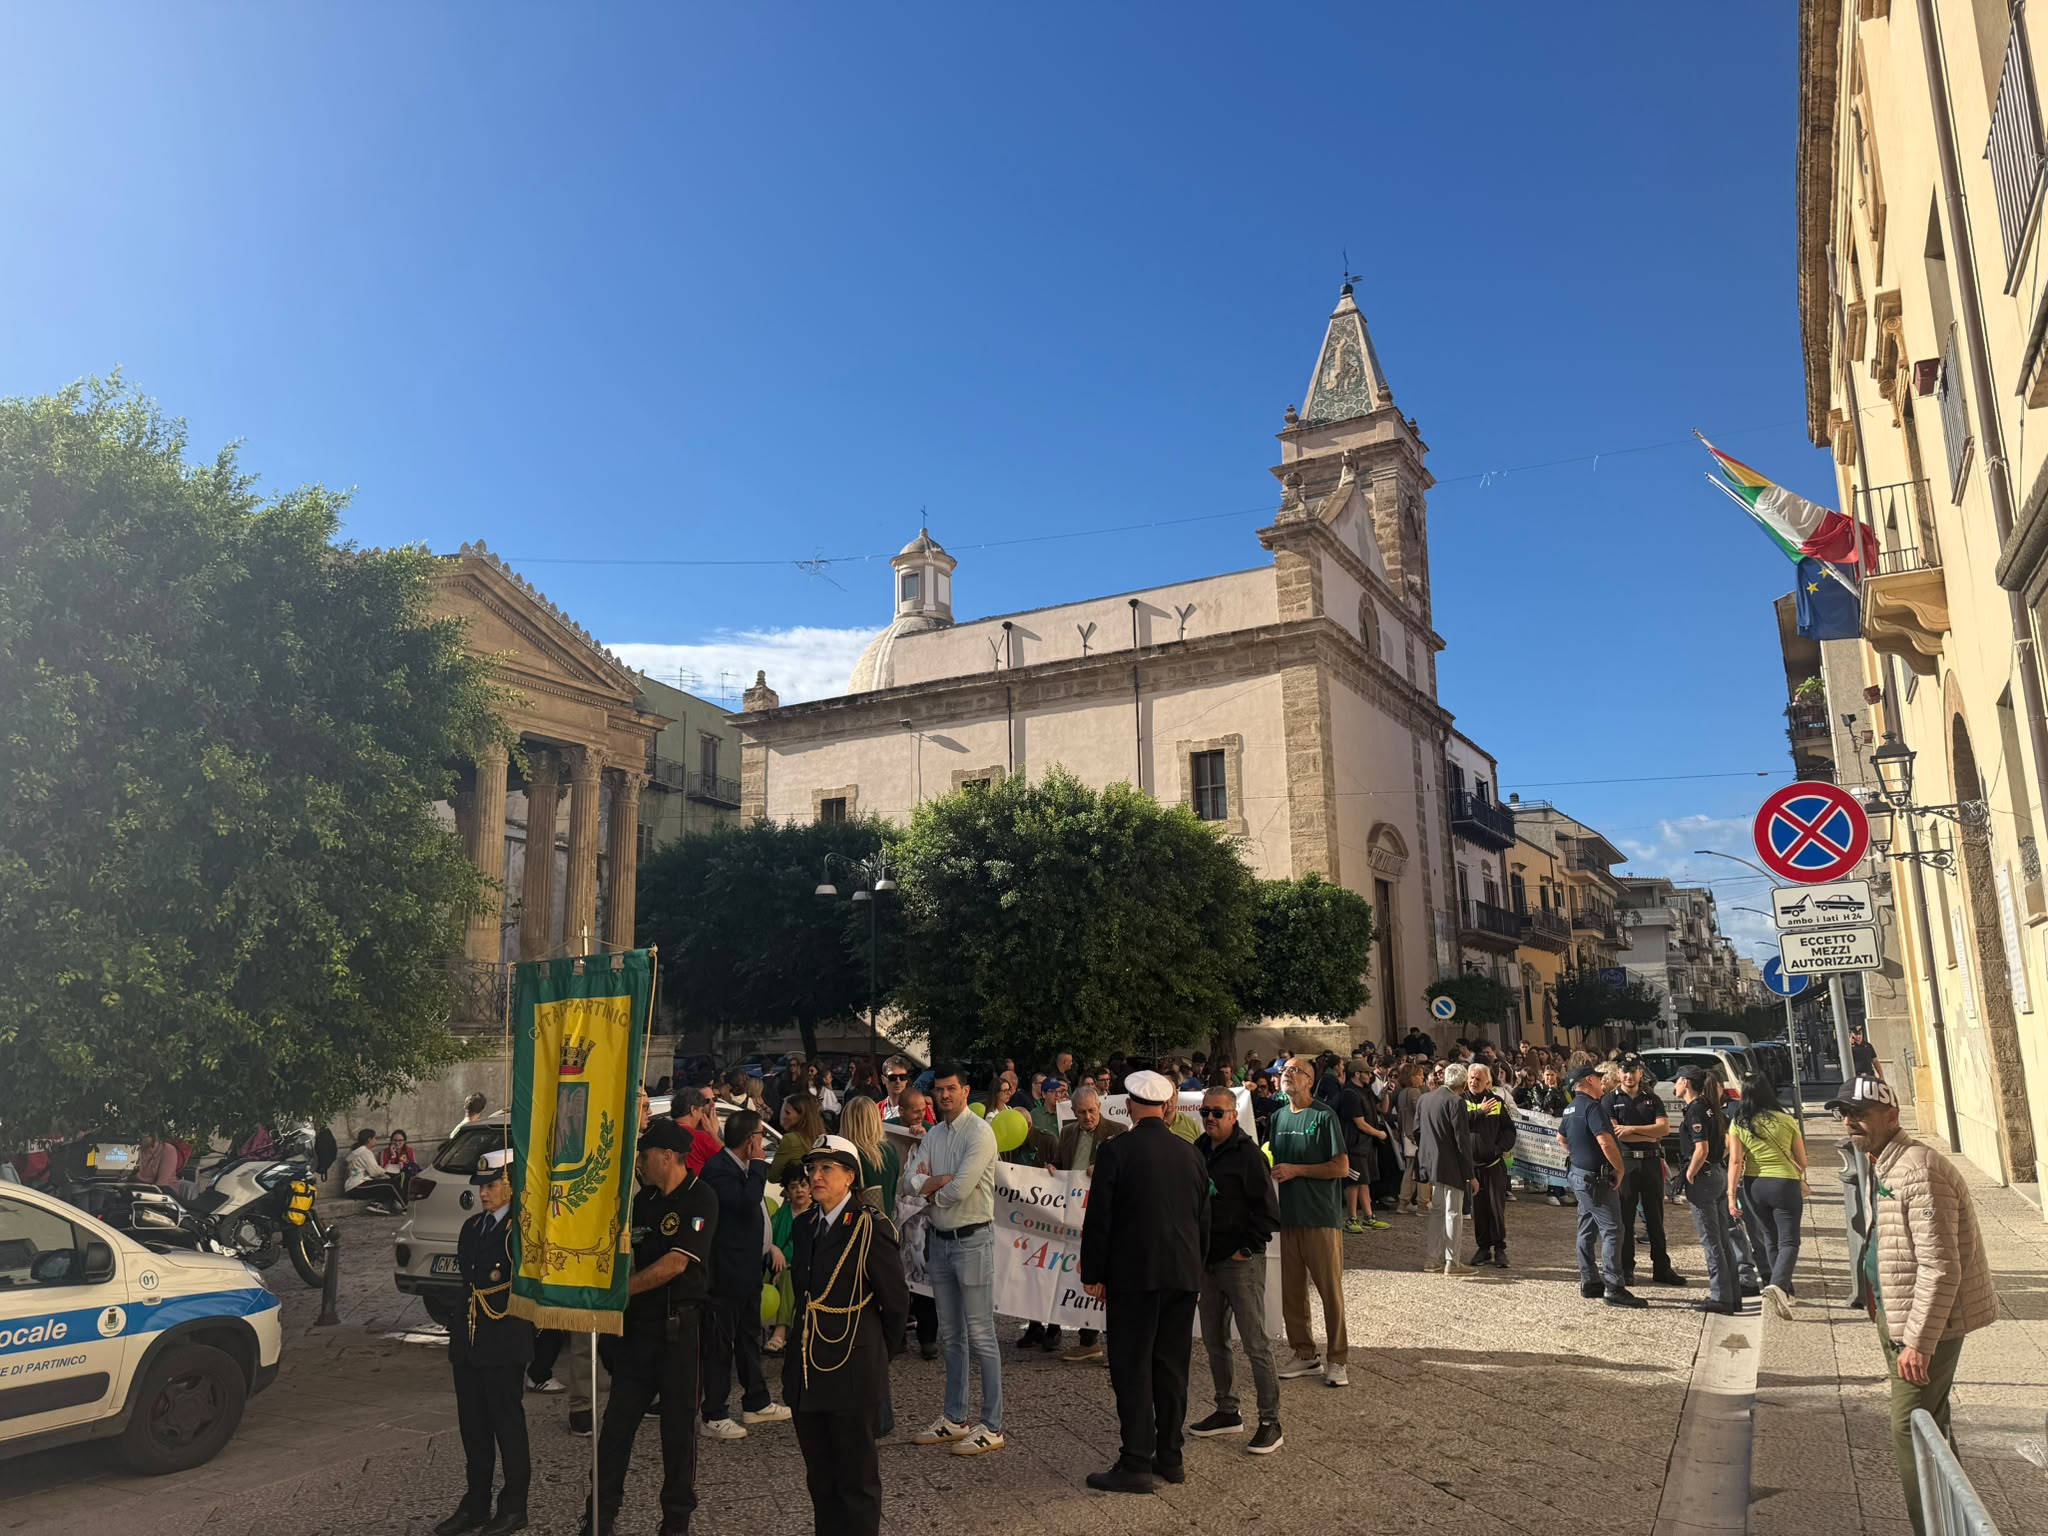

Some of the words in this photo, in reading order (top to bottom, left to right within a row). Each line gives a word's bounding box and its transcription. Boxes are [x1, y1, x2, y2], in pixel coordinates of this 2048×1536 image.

[1788, 917, 1813, 926] ambo
[1823, 914, 1839, 922] lati
[1800, 934, 1856, 947] ECCETTO
[1811, 945, 1851, 956] MEZZI
[1791, 954, 1873, 969] AUTORIZZATI
[143, 1275, 155, 1286] 01
[11, 1365, 24, 1376] DI
[25, 1354, 87, 1373] PARTINICO
